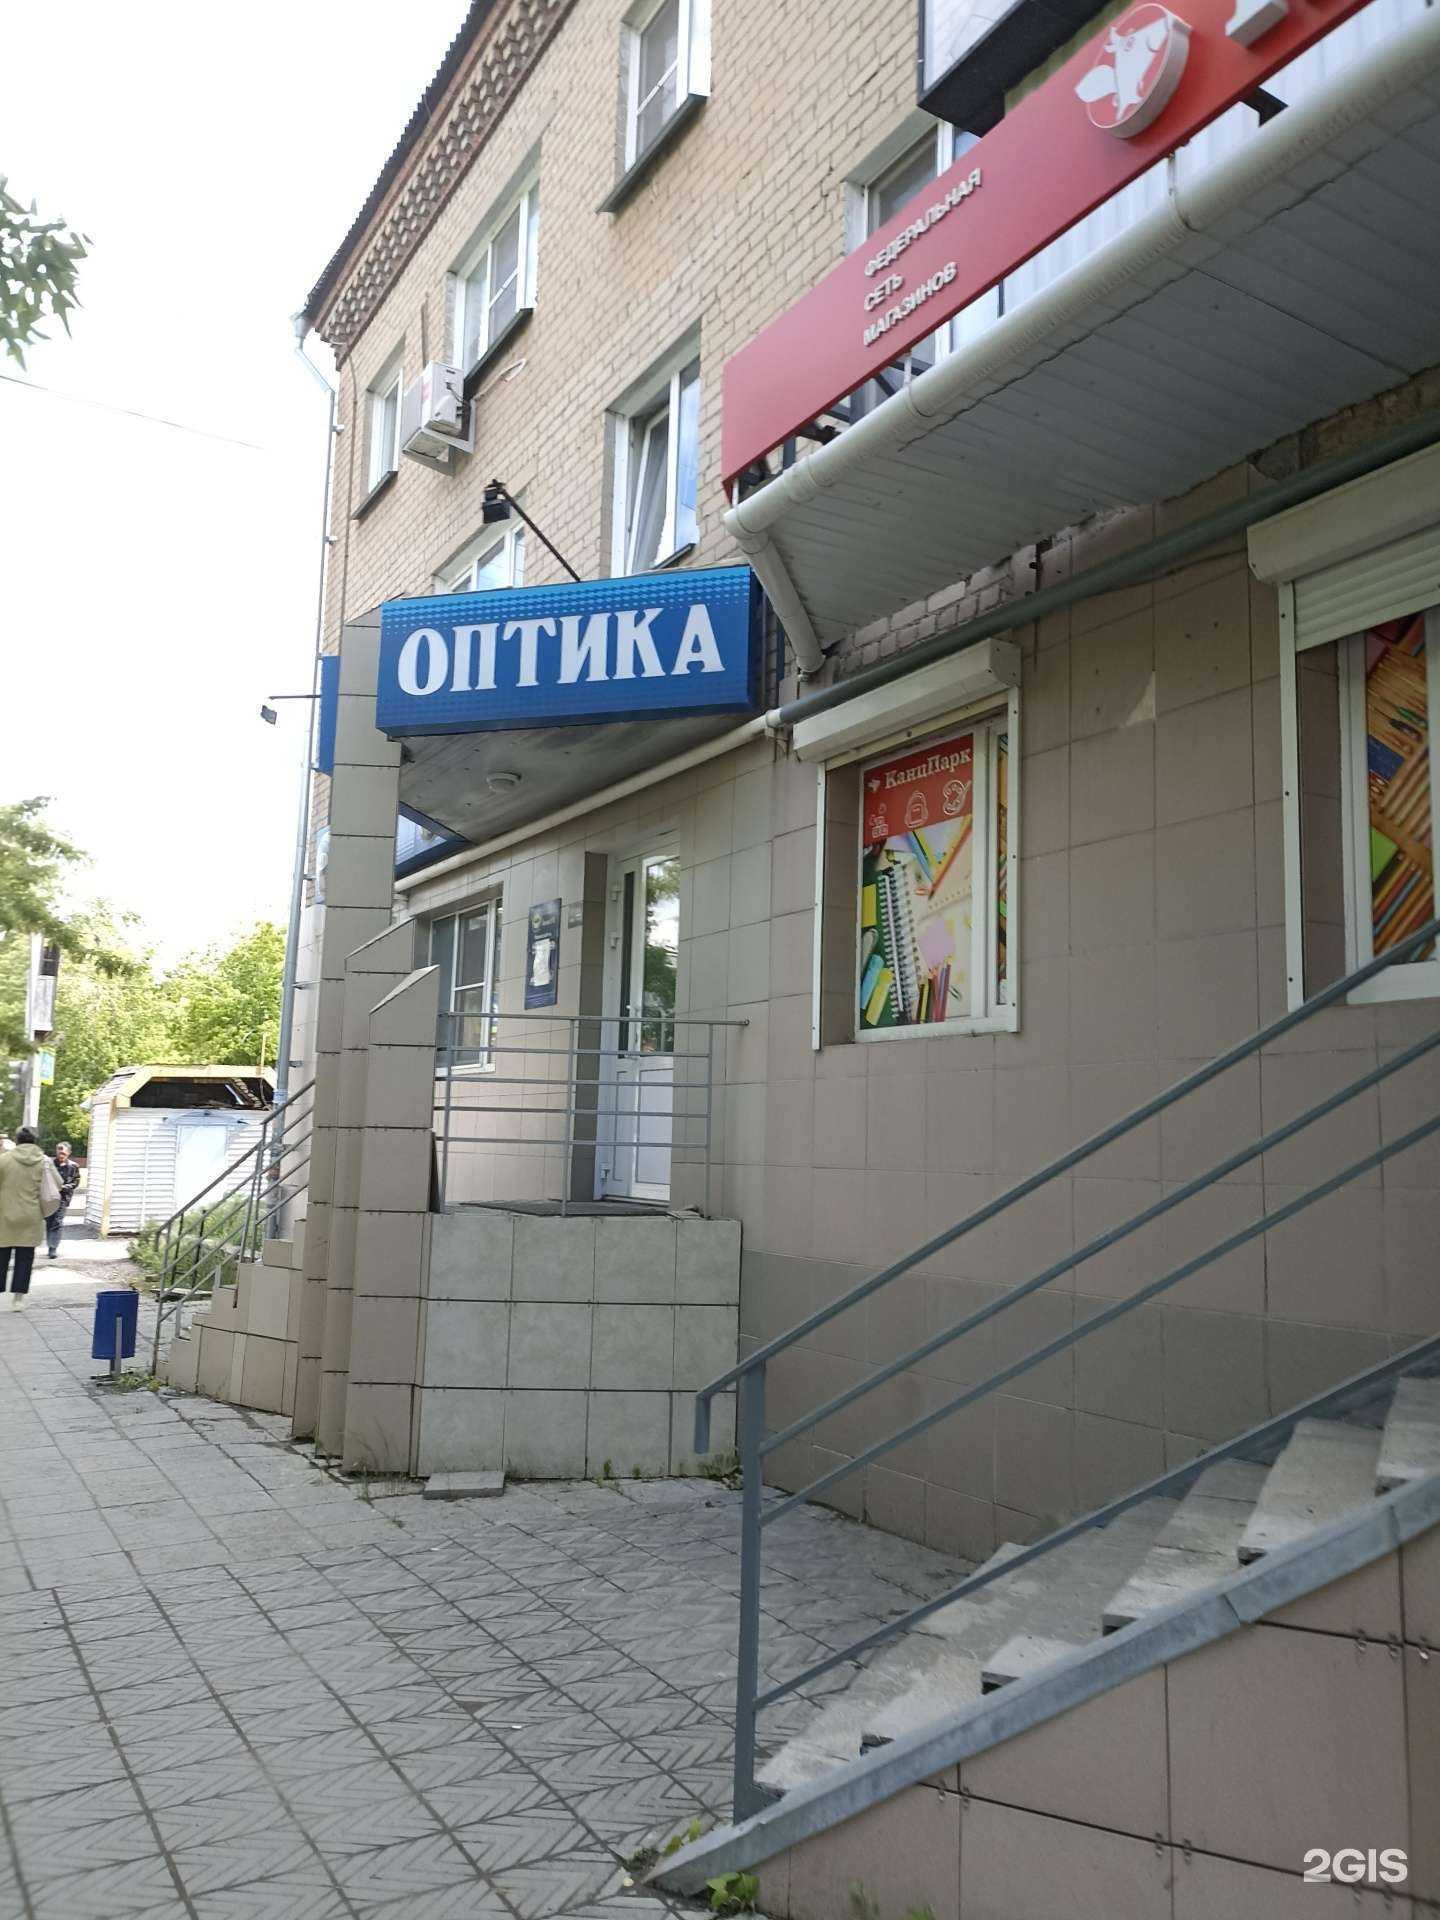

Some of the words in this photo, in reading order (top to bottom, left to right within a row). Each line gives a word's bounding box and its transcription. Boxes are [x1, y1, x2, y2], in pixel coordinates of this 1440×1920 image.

[865, 168, 982, 277] ФЕДЕРАЛЬНАЯ
[864, 273, 904, 312] СЕТЬ
[864, 262, 958, 346] МАГАЗИНОВ
[397, 604, 726, 696] ОПТИКА
[885, 748, 972, 789] КанцПарк
